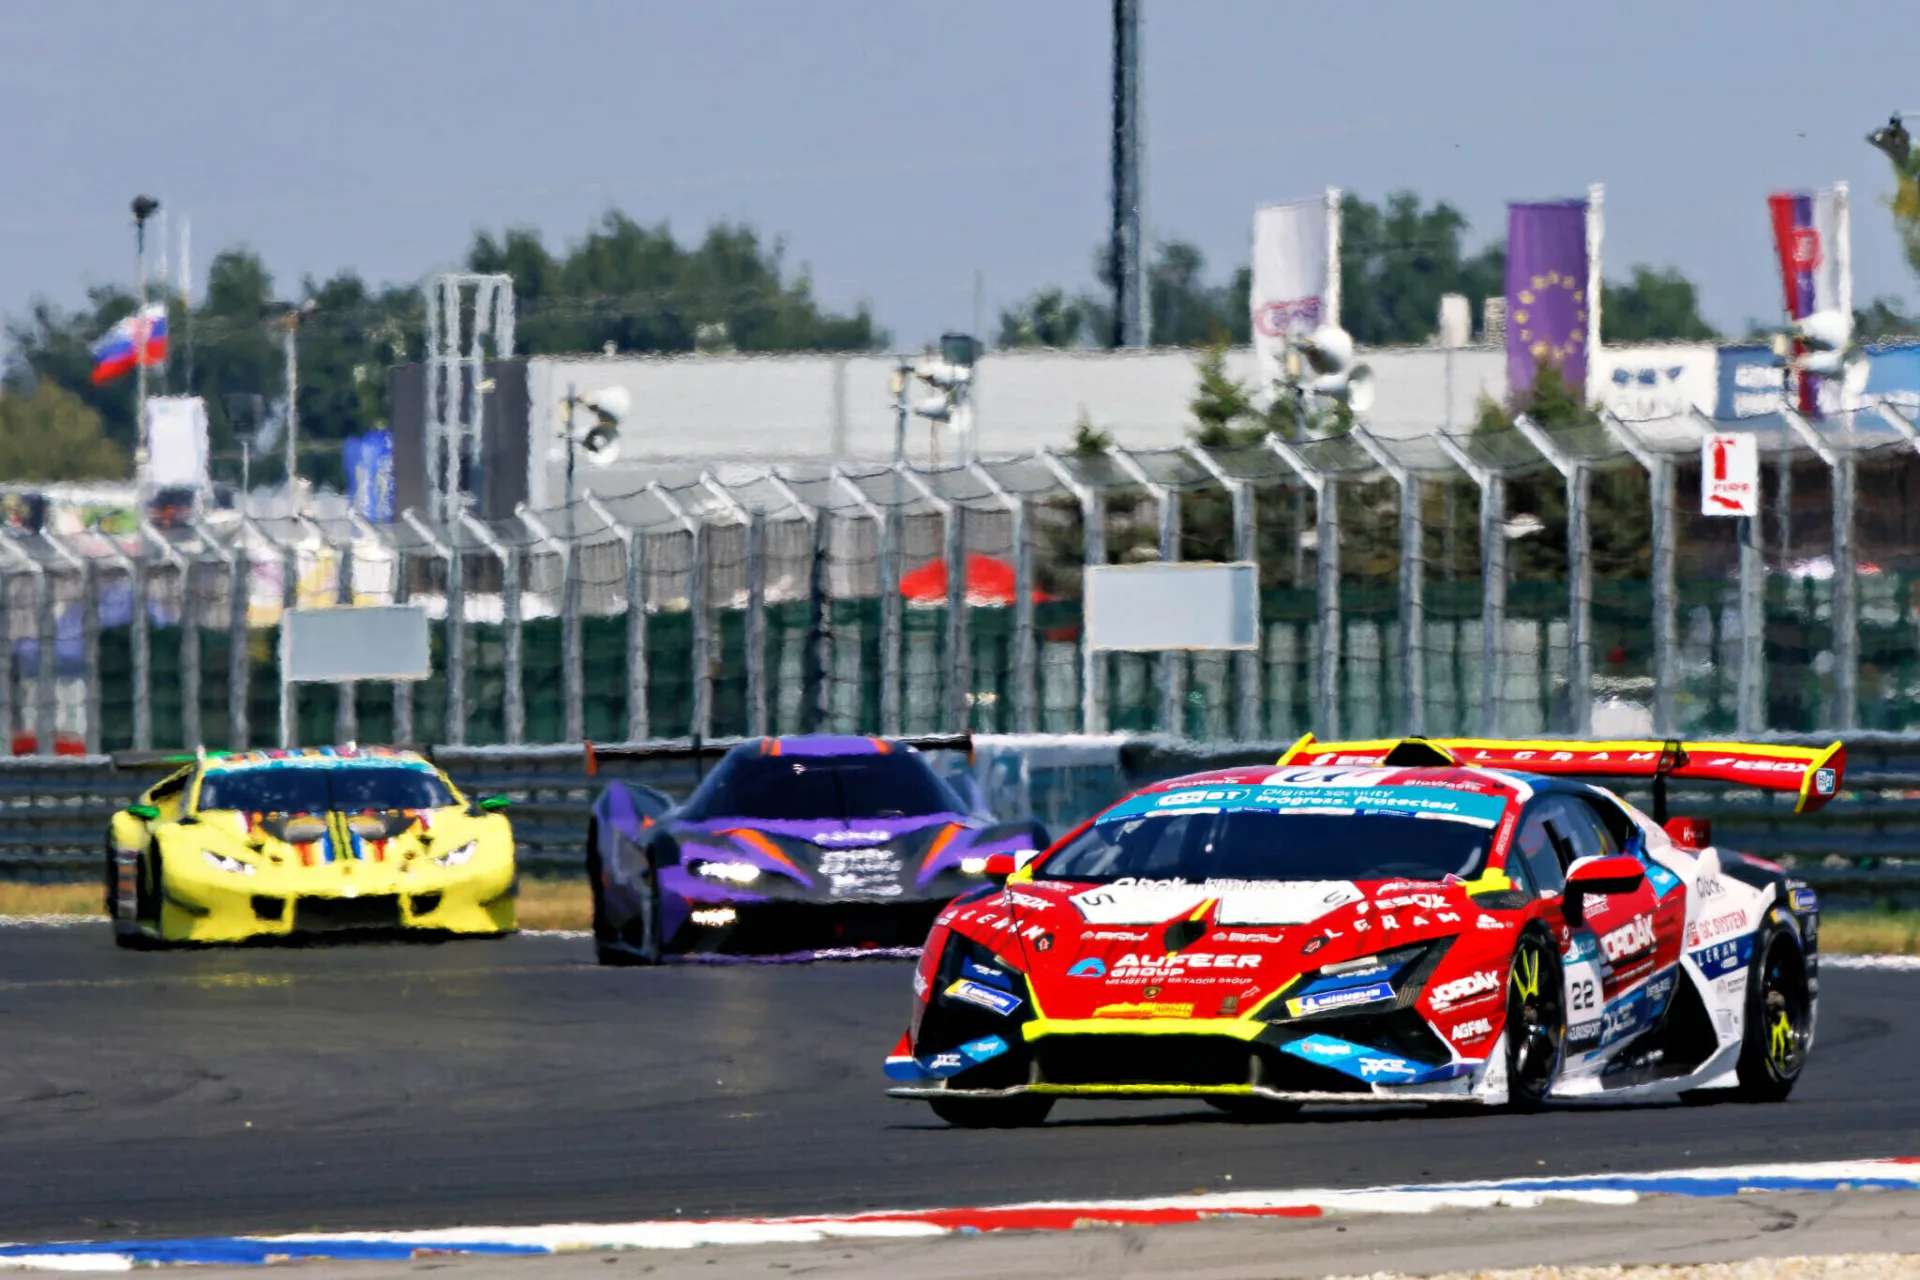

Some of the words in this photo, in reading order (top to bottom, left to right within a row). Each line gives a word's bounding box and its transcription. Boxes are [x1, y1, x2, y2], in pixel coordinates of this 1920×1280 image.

[1255, 795, 1349, 806] Progress.
[1354, 796, 1459, 812] Protected.
[1113, 953, 1262, 968] AUFEER
[1110, 967, 1185, 977] GROUP
[1571, 978, 1595, 1011] 22
